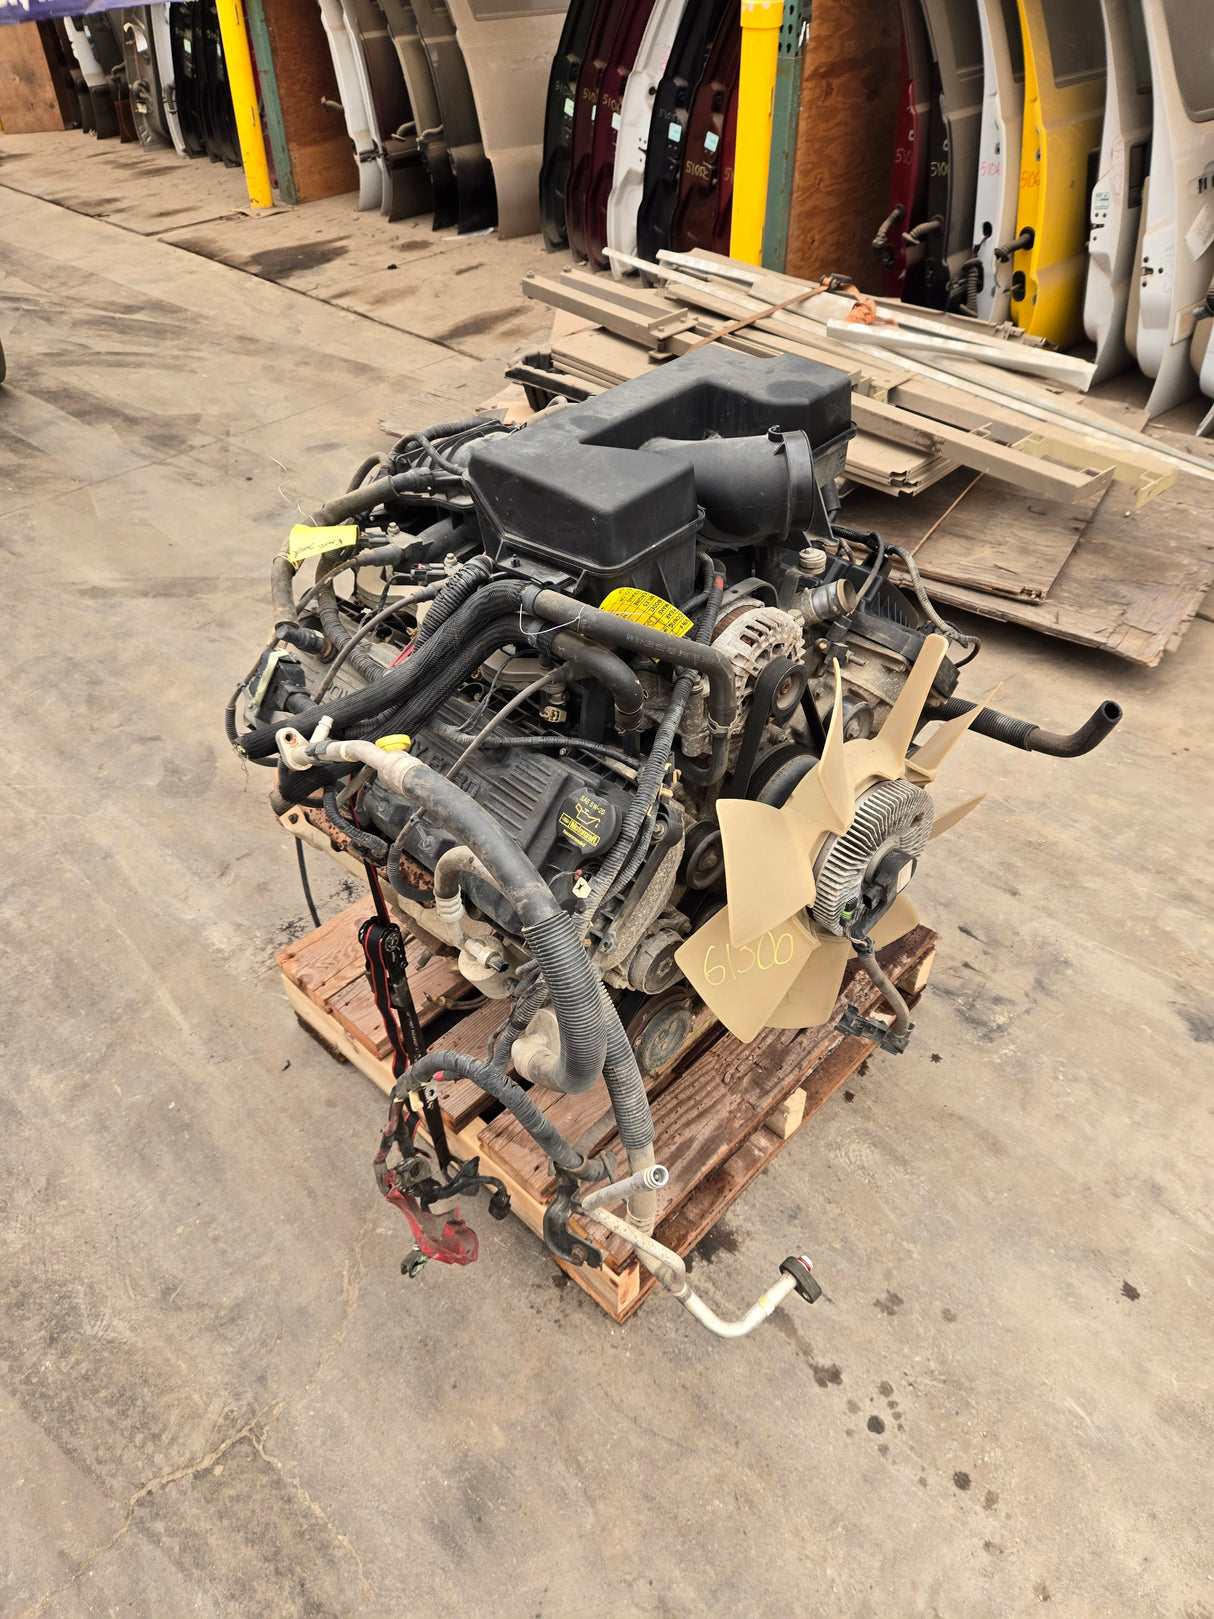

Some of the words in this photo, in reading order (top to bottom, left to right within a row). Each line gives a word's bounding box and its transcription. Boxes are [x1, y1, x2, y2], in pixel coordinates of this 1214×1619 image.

[665, 607, 677, 620] YEAR
[580, 795, 591, 805] SAE
[589, 801, 606, 816] 5W-20
